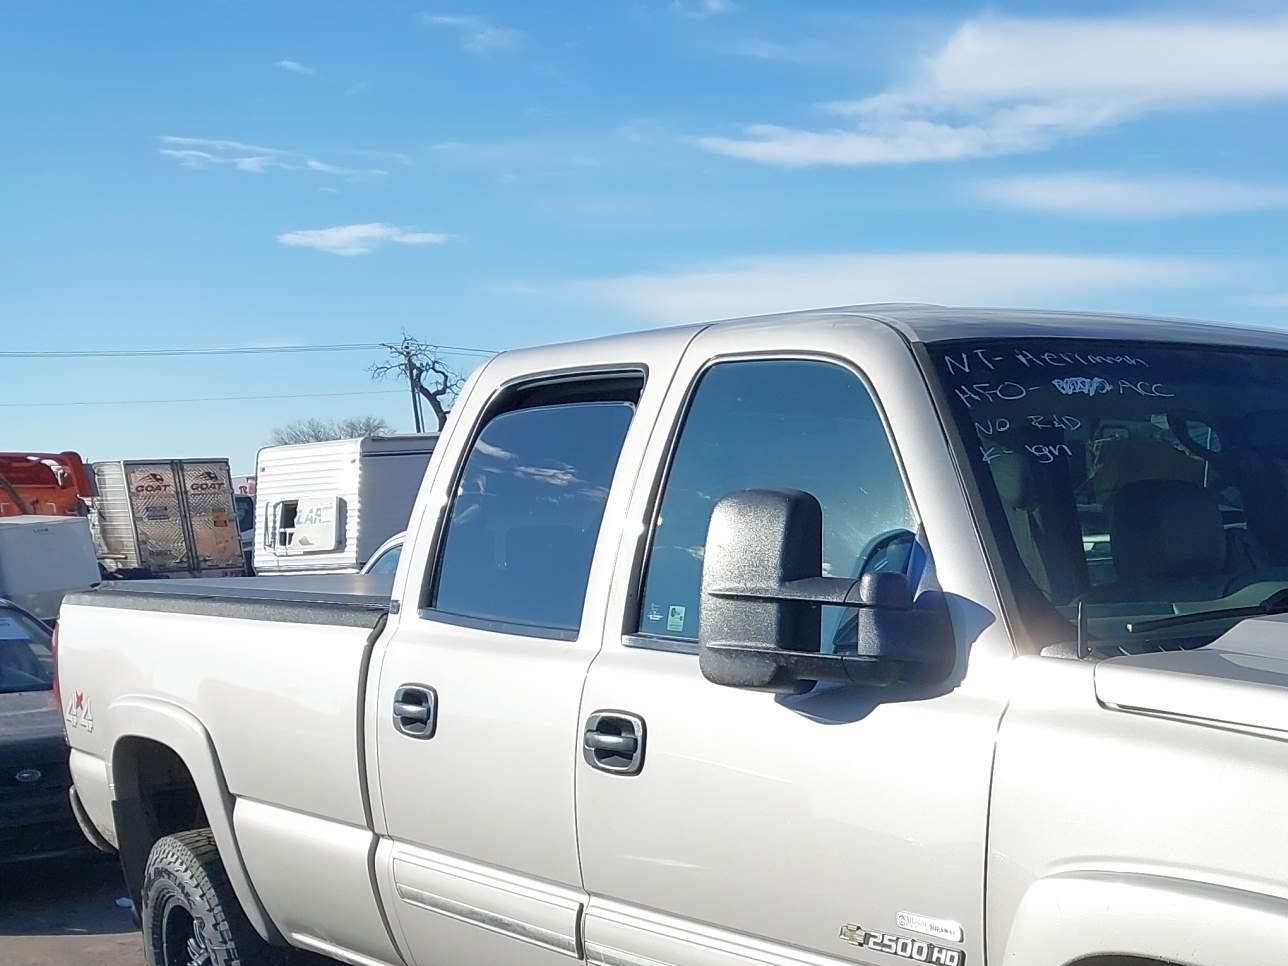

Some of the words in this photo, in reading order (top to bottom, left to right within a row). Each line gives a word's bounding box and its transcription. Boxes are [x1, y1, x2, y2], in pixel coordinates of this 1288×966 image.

[1118, 379, 1175, 397] ACC
[975, 417, 1010, 436] NO
[135, 483, 171, 493] GOAT
[190, 482, 225, 491] GOAT
[867, 930, 928, 961] 2500
